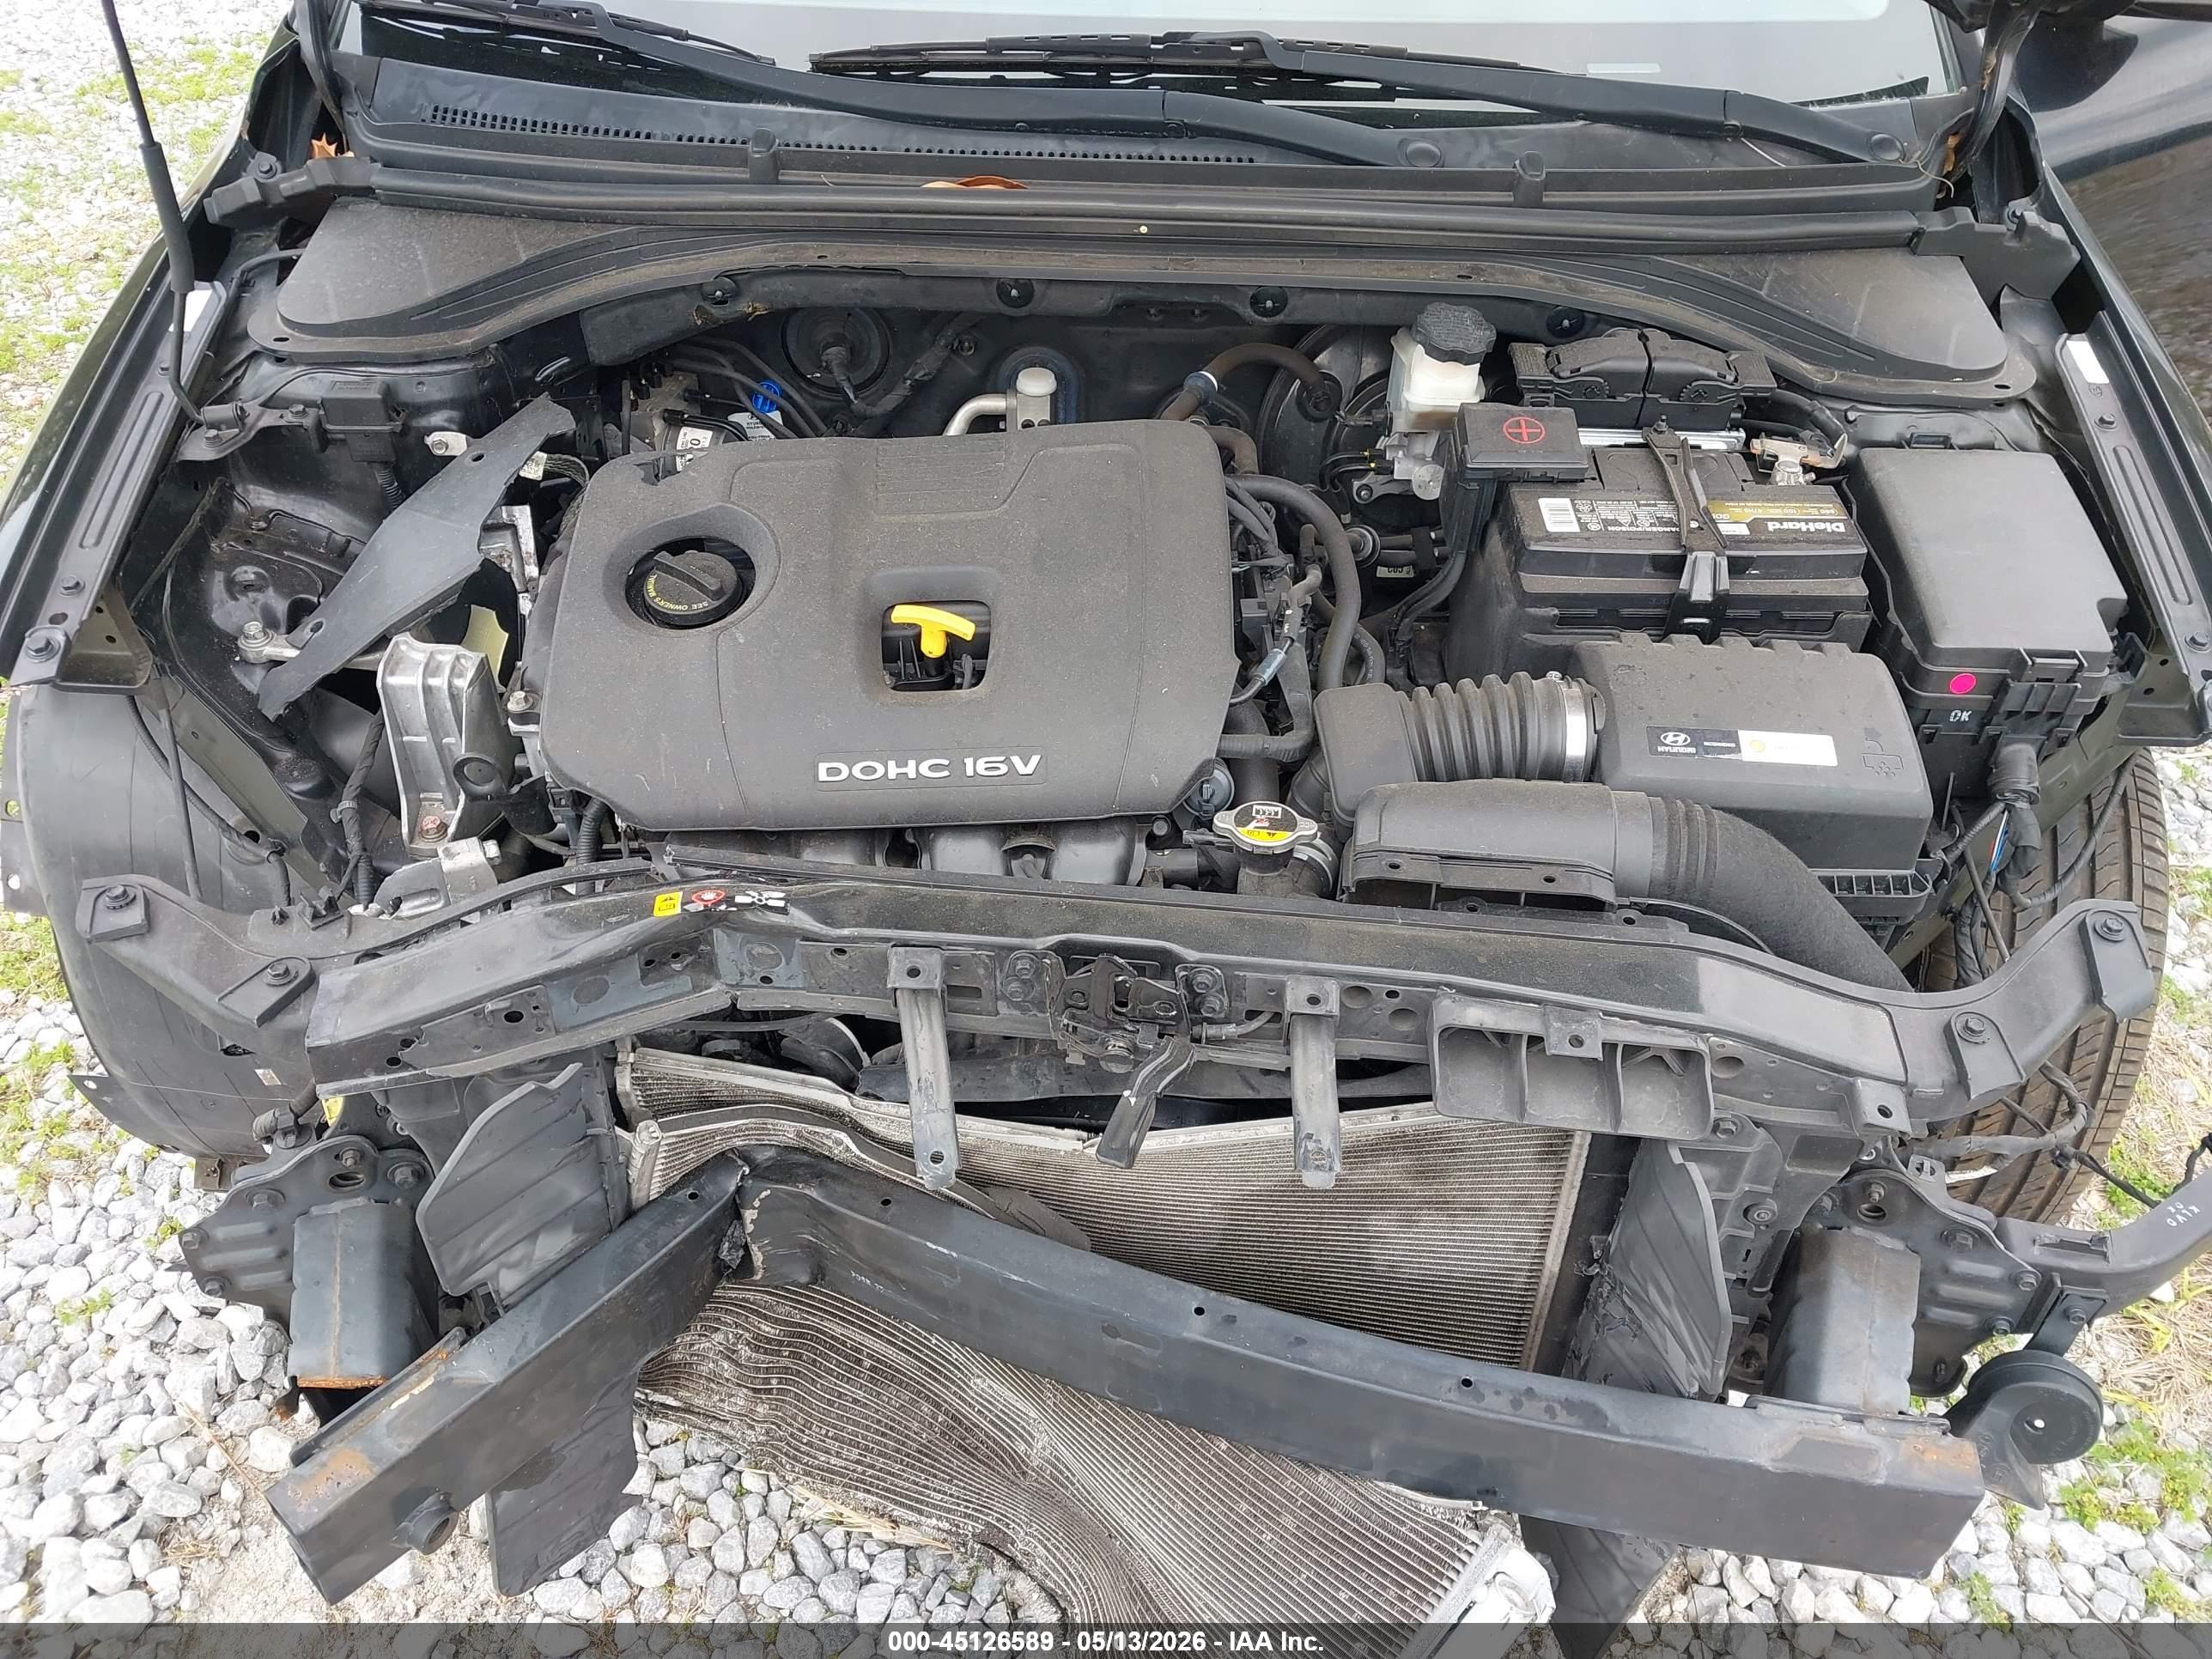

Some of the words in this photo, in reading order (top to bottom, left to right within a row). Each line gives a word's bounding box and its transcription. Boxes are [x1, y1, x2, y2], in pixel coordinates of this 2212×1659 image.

[1766, 521, 1845, 533] DieHard
[647, 574, 658, 598] MANUAL
[653, 597, 689, 611] OWNER'S
[691, 601, 708, 610] SEE
[1657, 745, 1697, 754] HYUNDAI
[817, 758, 951, 782] DOHC
[963, 755, 1042, 778] 16V
